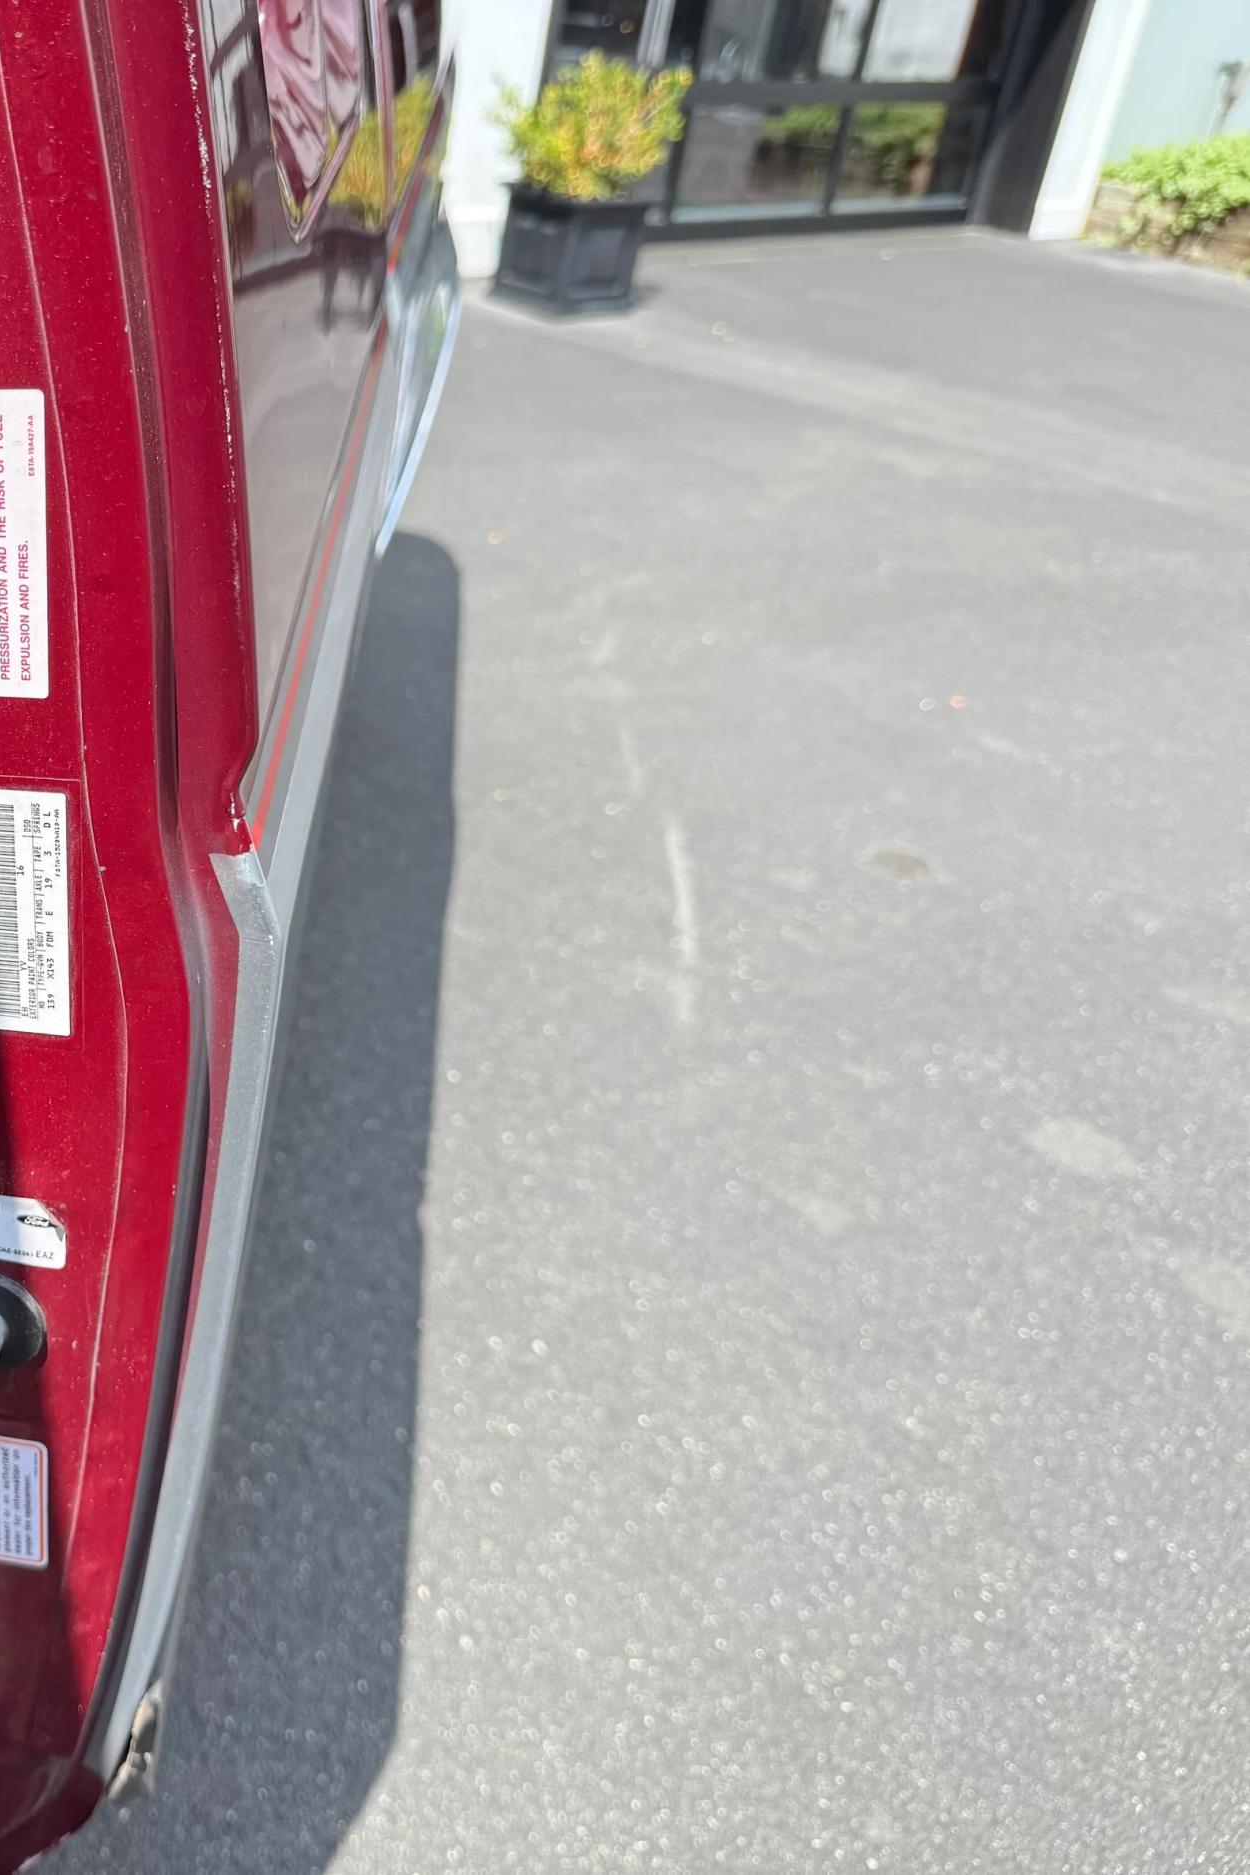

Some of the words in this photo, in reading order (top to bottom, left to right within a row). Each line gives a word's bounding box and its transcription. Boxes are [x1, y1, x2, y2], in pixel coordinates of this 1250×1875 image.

[19, 539, 28, 579] FIRES.
[20, 584, 29, 609] AND
[21, 614, 30, 680] EXPULSION
[33, 802, 41, 833] SPRINGS
[17, 864, 24, 876] 16
[45, 876, 52, 888] 19
[21, 959, 27, 971] YV
[22, 1006, 28, 1016] EH
[23, 1214, 49, 1227] Ford
